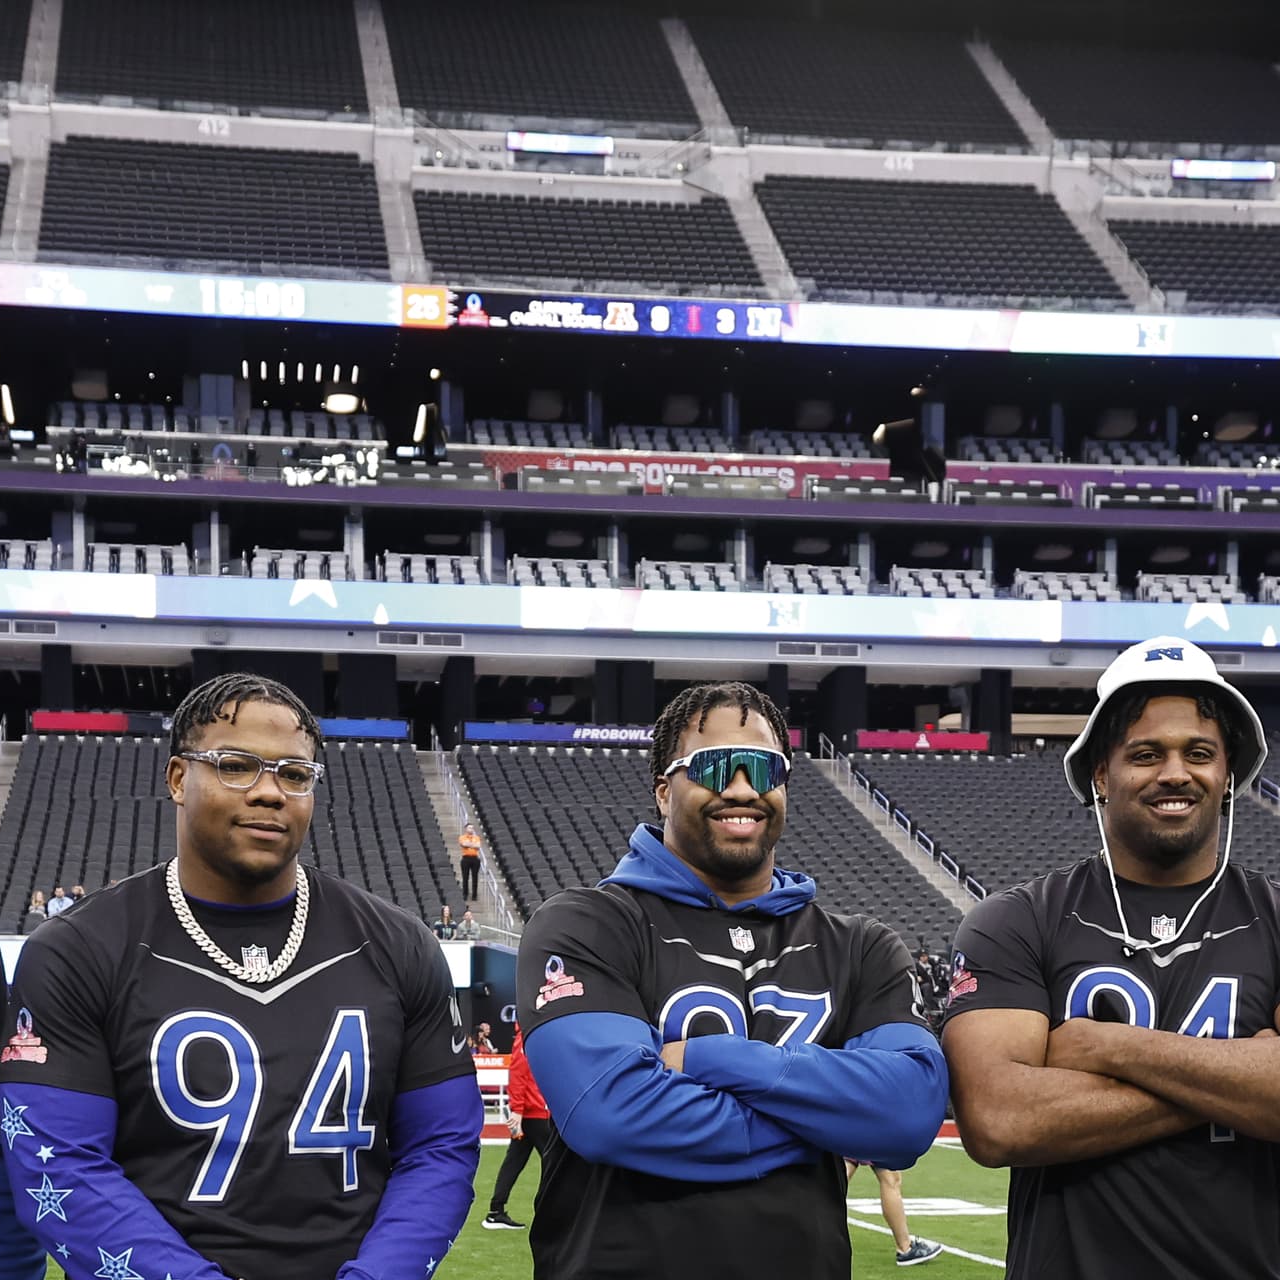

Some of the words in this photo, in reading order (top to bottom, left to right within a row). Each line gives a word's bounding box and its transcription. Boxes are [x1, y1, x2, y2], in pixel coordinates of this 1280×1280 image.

[198, 118, 230, 136] 412
[883, 155, 914, 171] 414
[199, 278, 305, 318] 15:00
[406, 294, 441, 321] 25
[148, 1008, 377, 1203] 94
